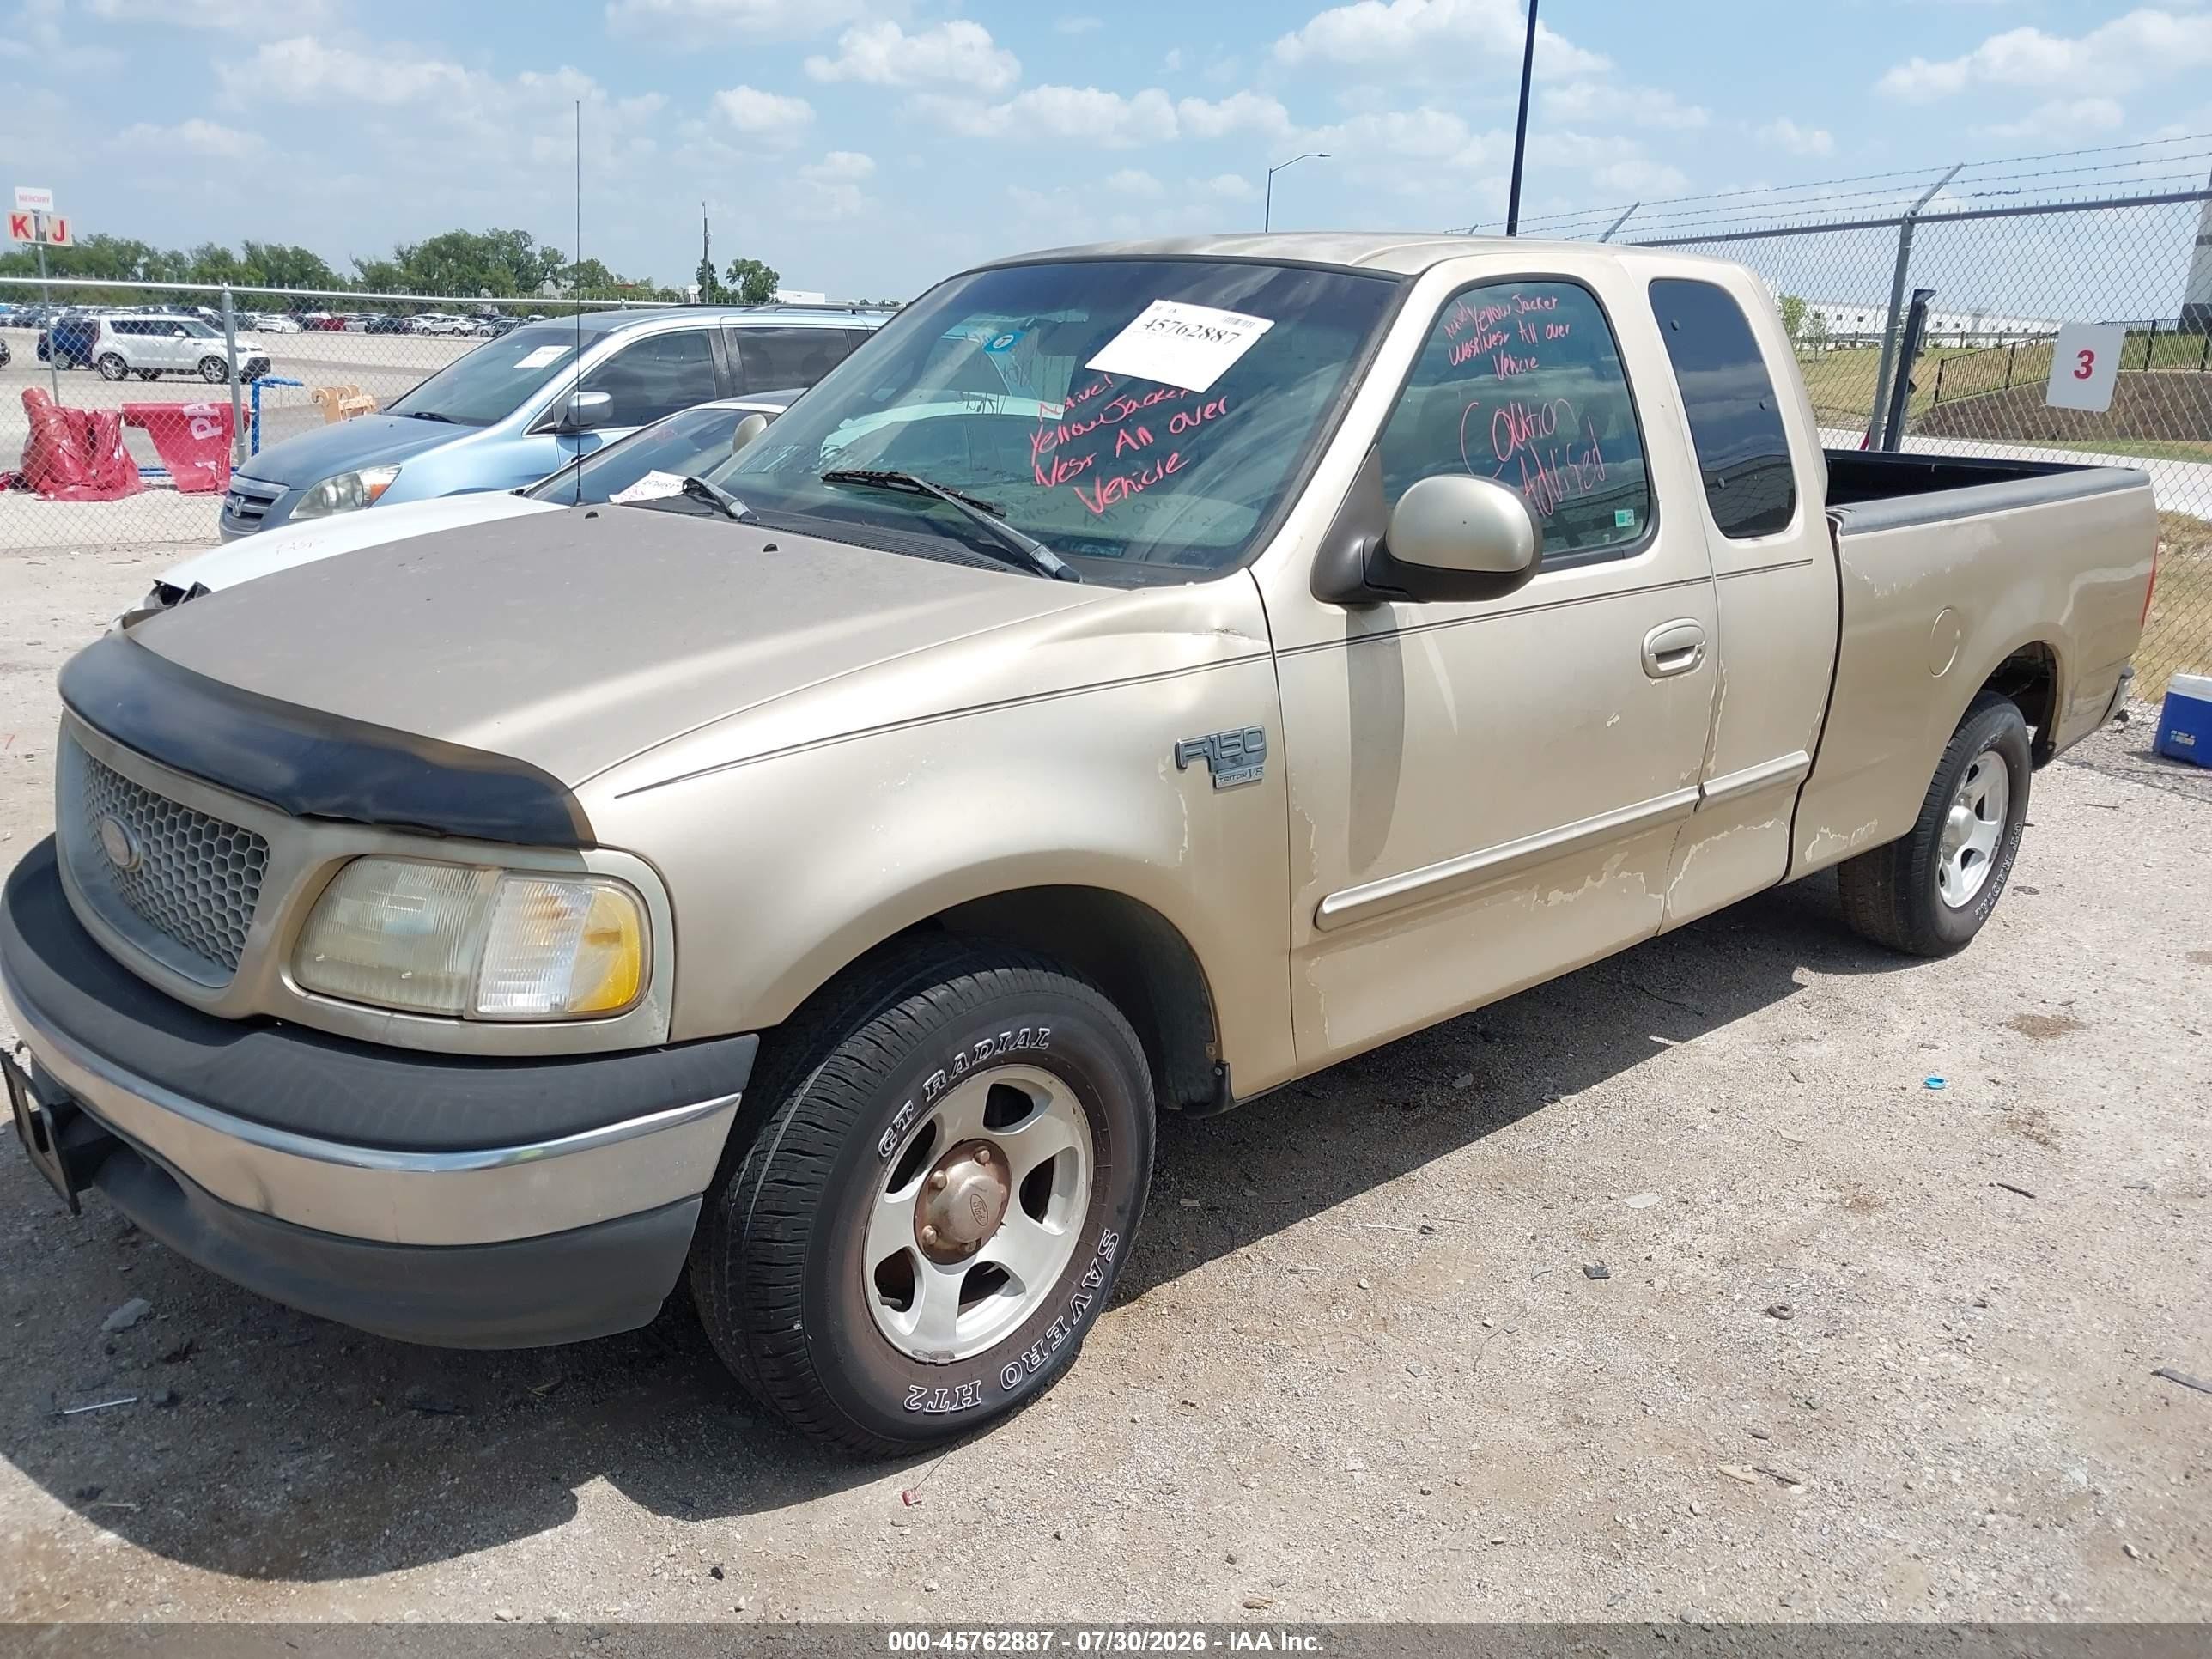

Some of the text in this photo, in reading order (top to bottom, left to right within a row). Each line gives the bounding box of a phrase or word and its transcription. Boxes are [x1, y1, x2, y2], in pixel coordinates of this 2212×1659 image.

[11, 214, 32, 240] K
[52, 219, 65, 242] J
[1142, 318, 1242, 345] 45762887
[2074, 349, 2095, 380] 3
[1030, 413, 1106, 467] Yellow
[878, 1027, 1052, 1158] GT RADIAL
[904, 1228, 1119, 1414] SAVERO HT2
